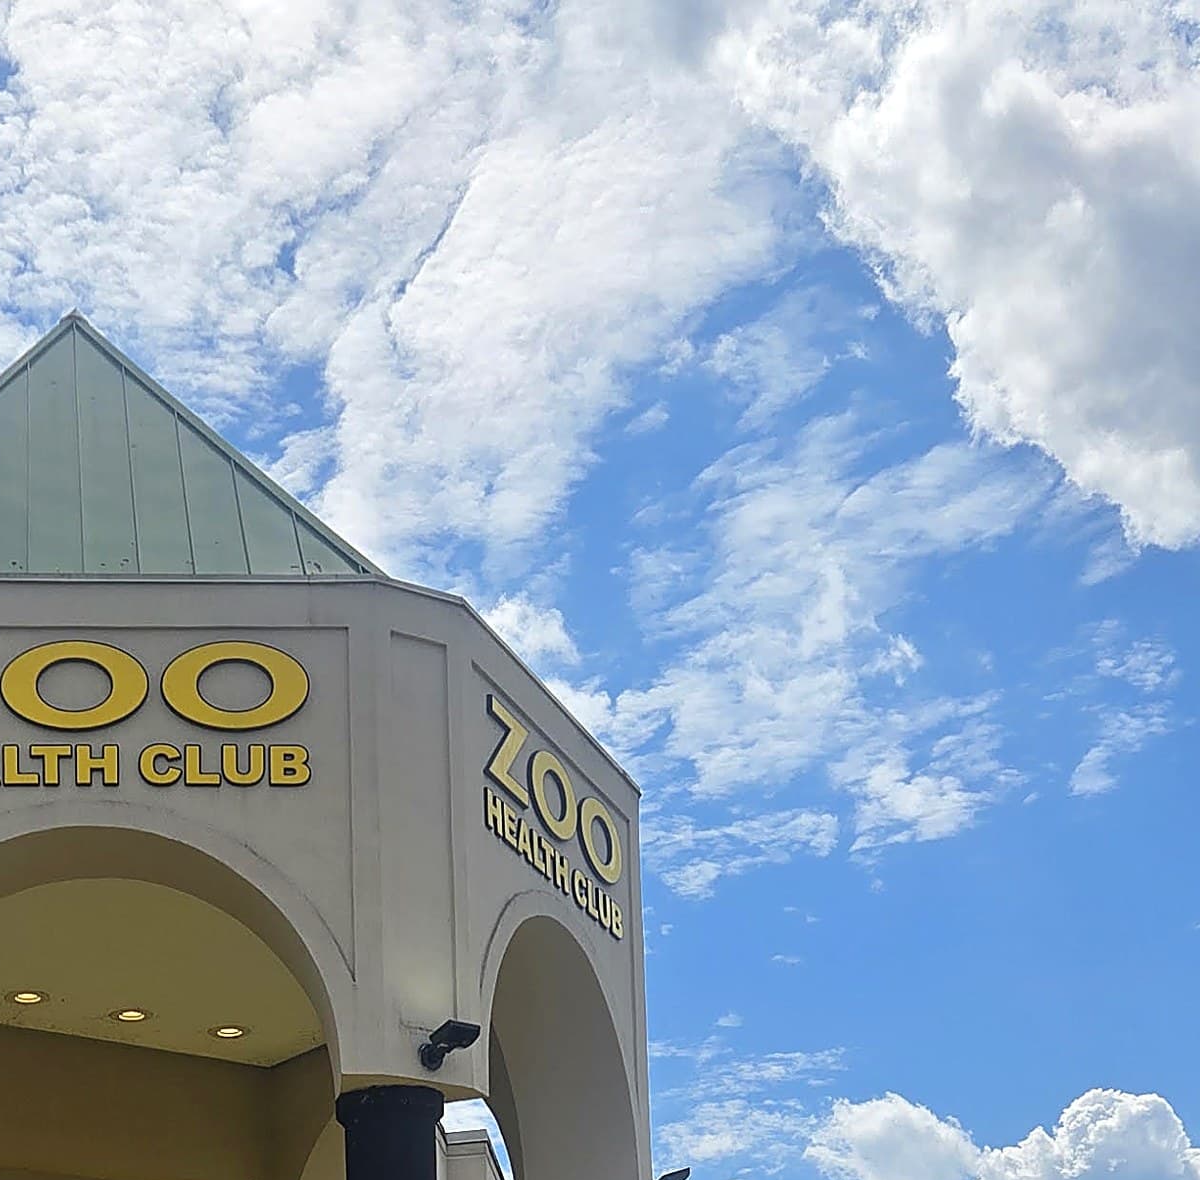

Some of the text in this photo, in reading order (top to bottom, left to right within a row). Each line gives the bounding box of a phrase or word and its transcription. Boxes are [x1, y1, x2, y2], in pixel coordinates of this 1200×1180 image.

[139, 743, 313, 787] CLUB
[484, 694, 623, 885] ZOO
[484, 787, 625, 941] HEALTH CLUB
